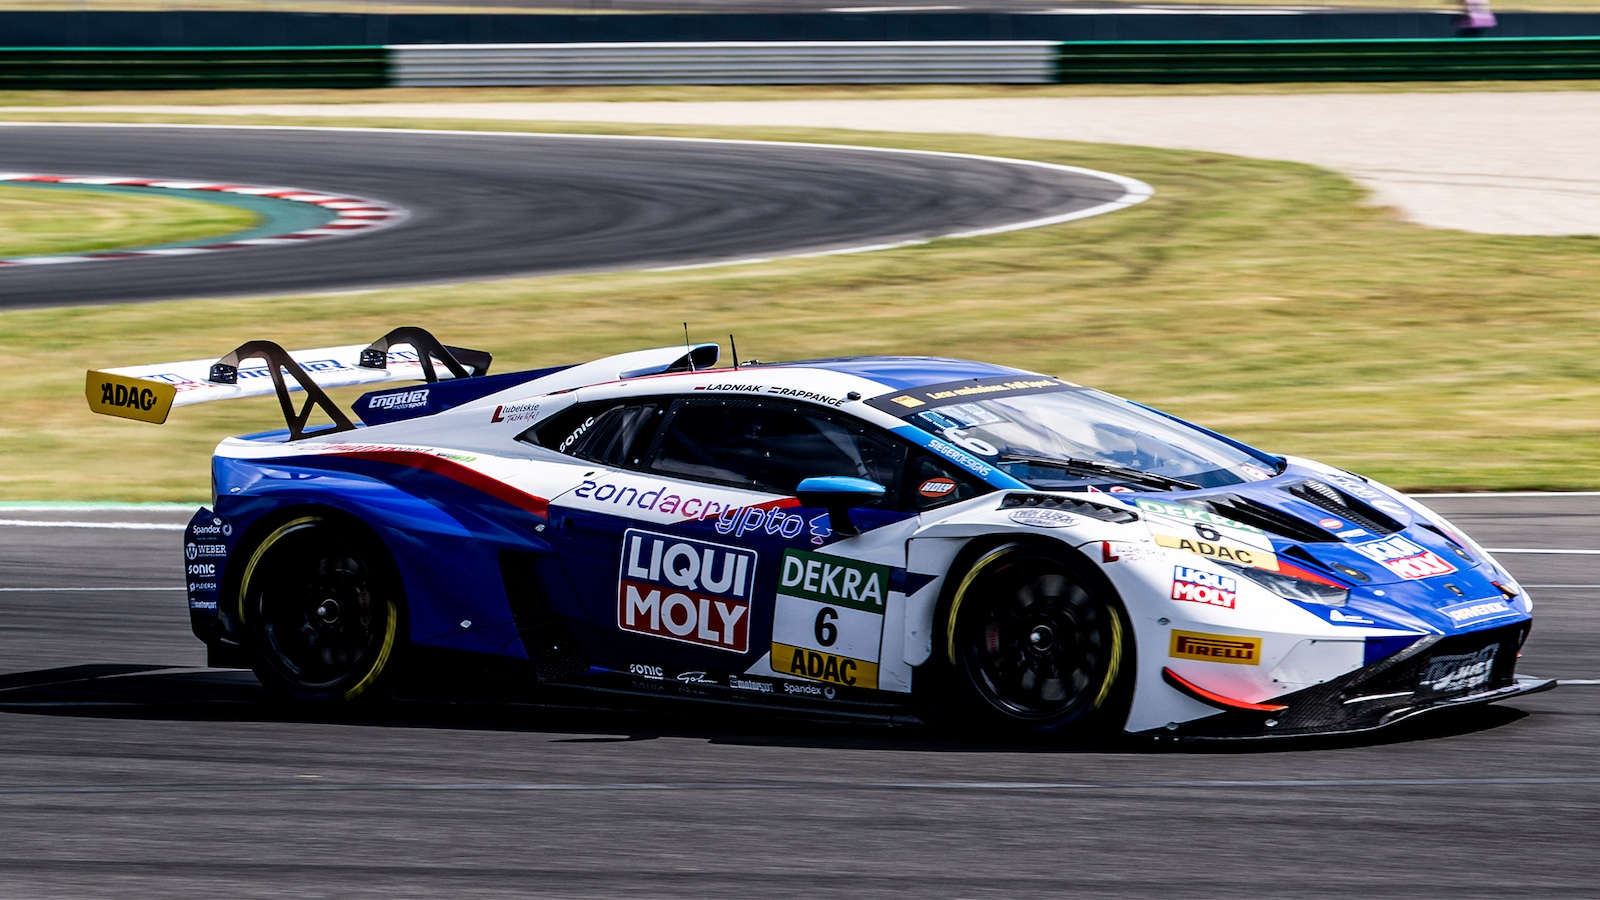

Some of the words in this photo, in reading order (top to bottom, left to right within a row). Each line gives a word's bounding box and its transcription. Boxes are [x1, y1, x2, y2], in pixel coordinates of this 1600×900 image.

[102, 382, 154, 411] ADAC
[368, 389, 430, 409] Engstler
[705, 383, 763, 393] LADNIAK
[779, 388, 845, 408] RAPPANGE
[393, 401, 427, 410] motorsport
[943, 427, 999, 456] 6
[927, 439, 991, 476] SIEGERDESIGNS
[574, 480, 804, 538] zondacrypto
[193, 525, 220, 535] Spandex
[1194, 523, 1222, 542] 6
[198, 545, 227, 554] WEBER
[1180, 539, 1253, 564] ADAC
[628, 536, 748, 596] LIQUI
[781, 555, 883, 605] DEKRA
[1174, 567, 1236, 592] LIQUI
[1173, 582, 1236, 607] MOLY
[625, 585, 747, 645] MOLY
[814, 606, 839, 647] 6
[1176, 636, 1254, 659] PIRELLI
[790, 648, 857, 687] ADAC
[784, 682, 822, 694] Spandex
